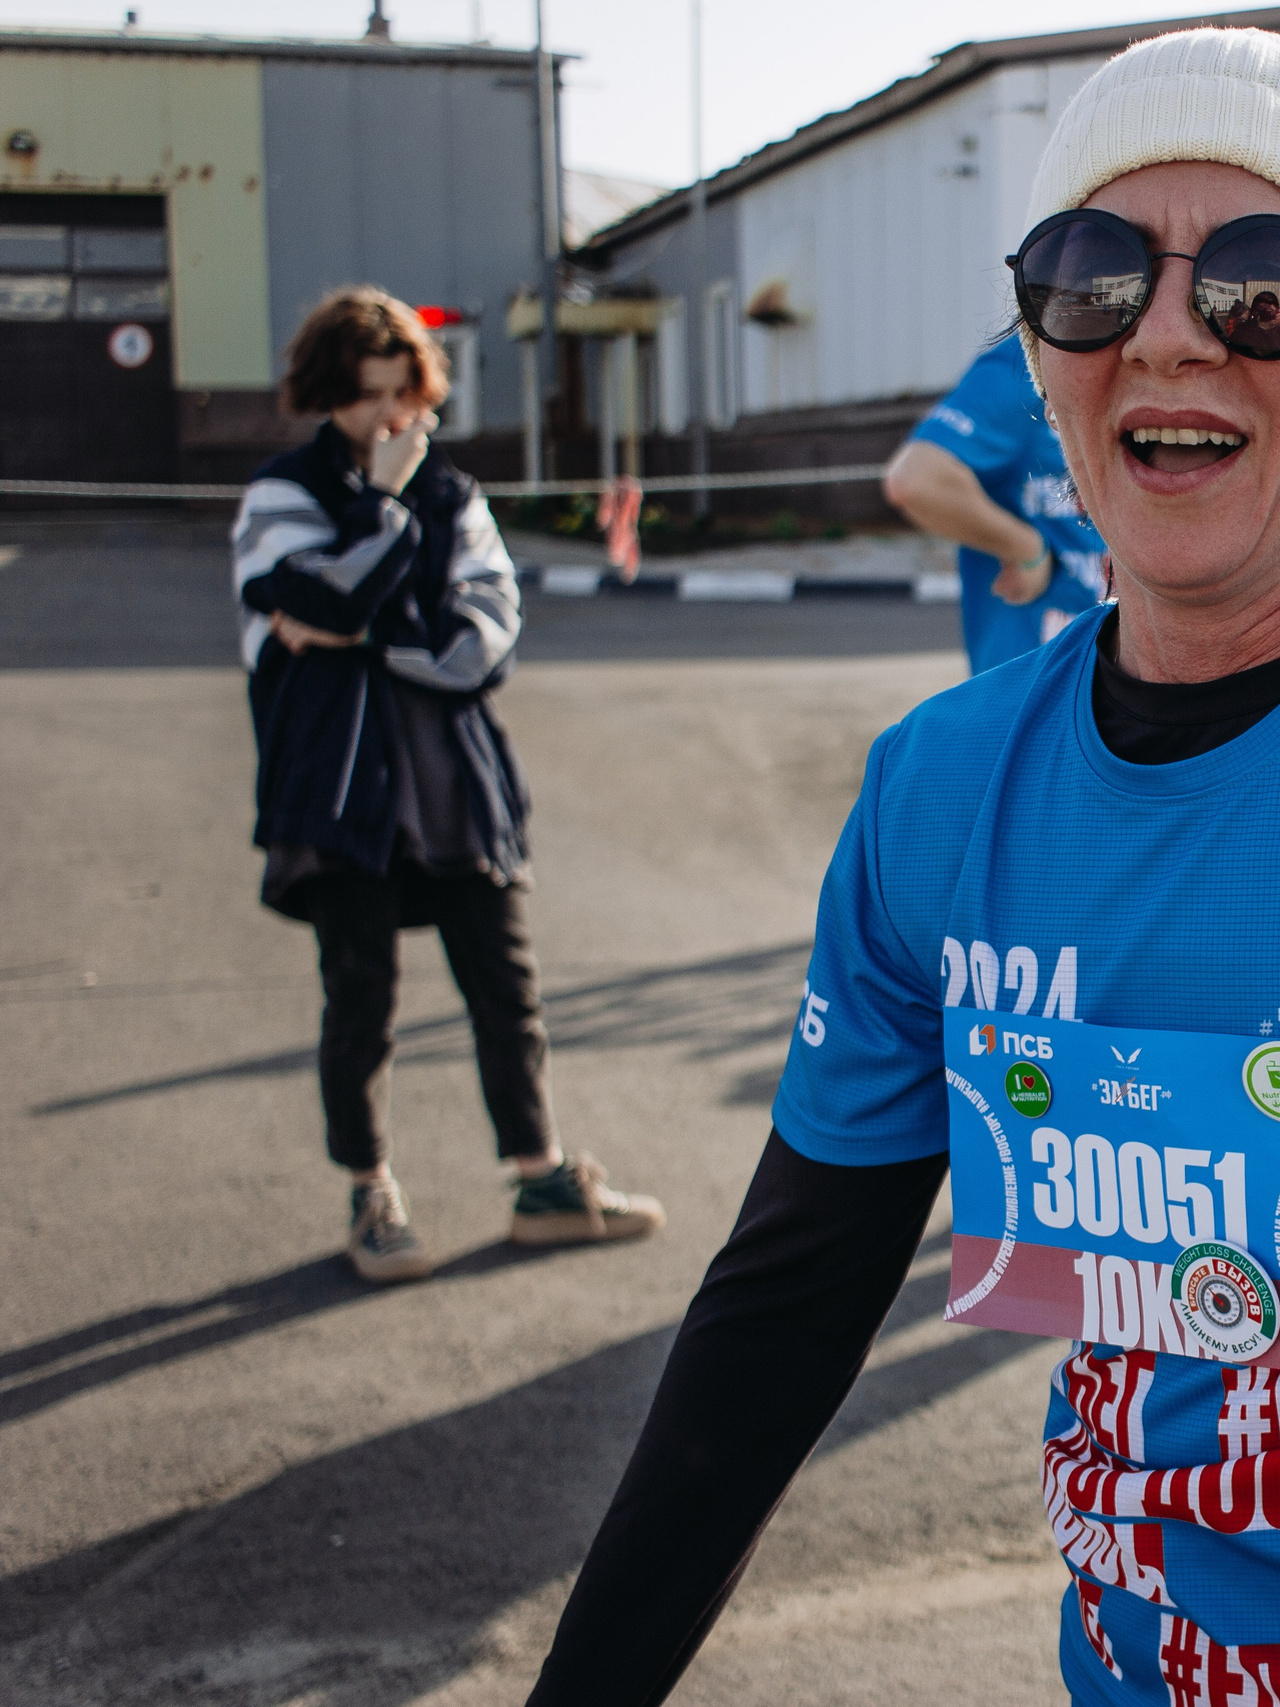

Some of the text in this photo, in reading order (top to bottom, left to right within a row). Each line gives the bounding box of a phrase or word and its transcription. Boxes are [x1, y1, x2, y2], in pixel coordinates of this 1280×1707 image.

[1003, 1031, 1053, 1060] ПСБ
[1031, 1126, 1248, 1252] 30051
[1174, 1247, 1201, 1277] WEIGHT
[1203, 1244, 1230, 1259] LOSS
[1232, 1254, 1275, 1316] CHALLENGE
[1216, 1260, 1261, 1316] ВЫЗОВ
[1180, 1302, 1229, 1353] ЛИШНЕМУ
[1231, 1332, 1262, 1354] ВЕСУ!
